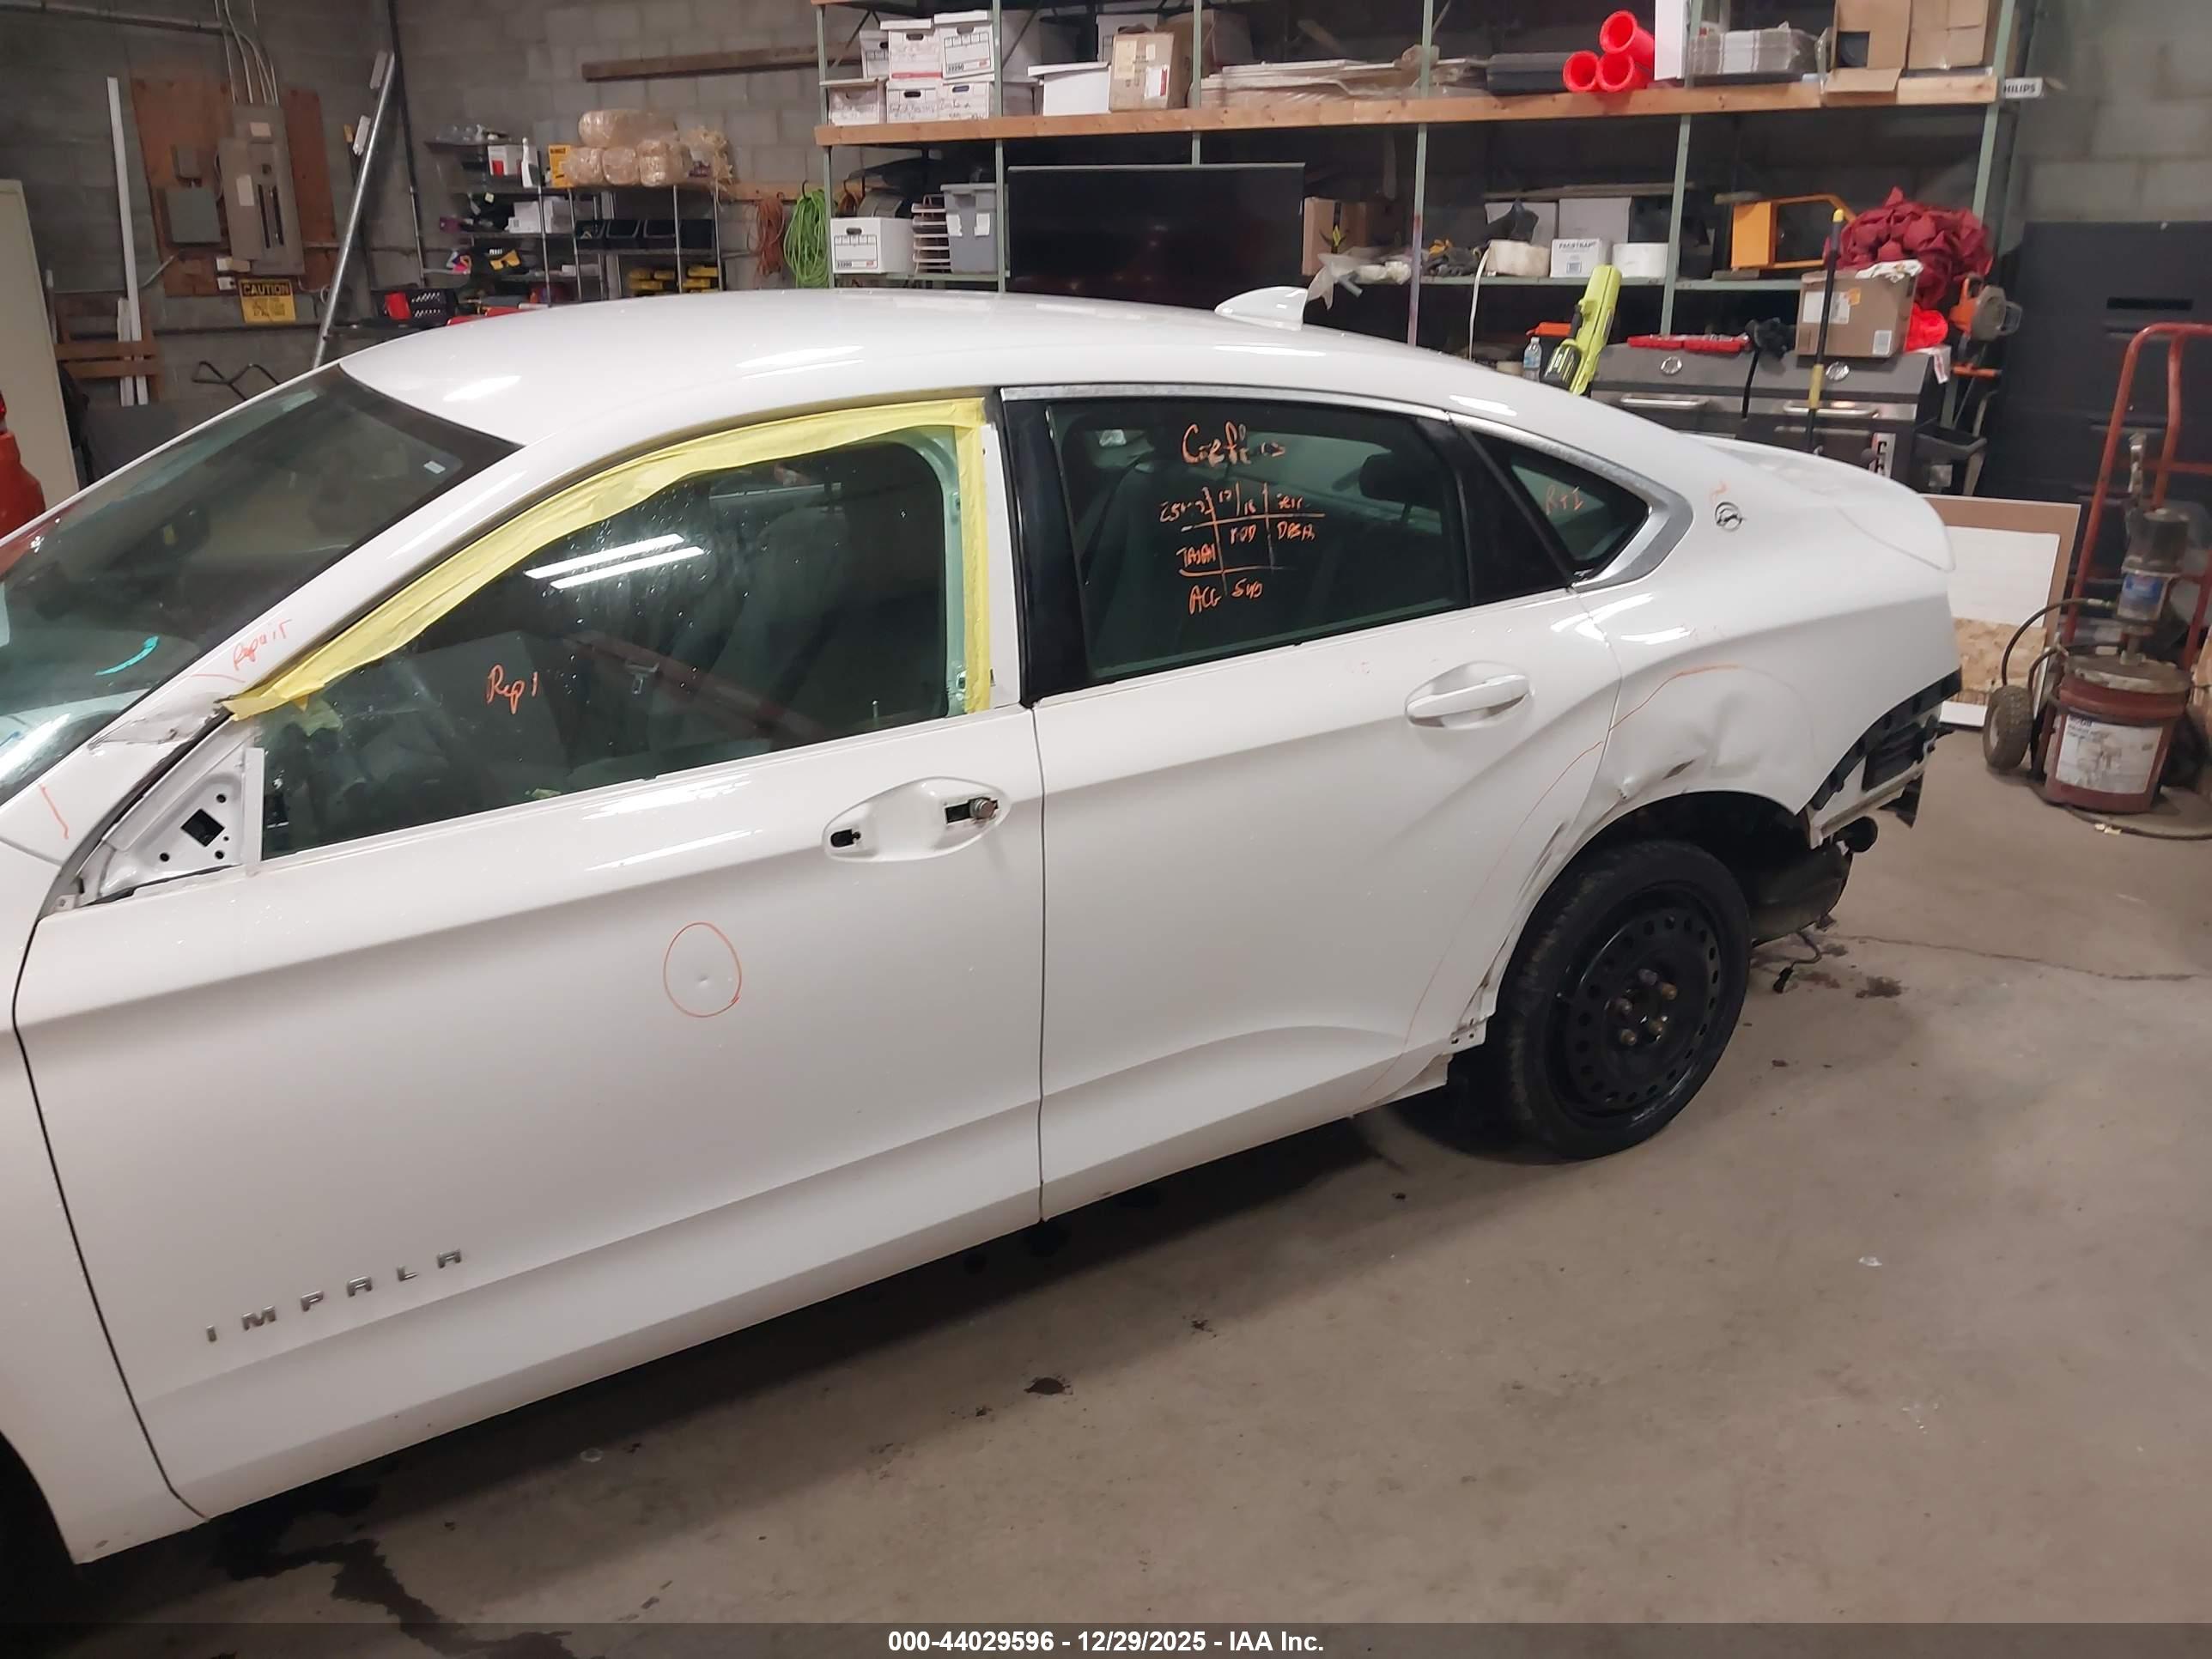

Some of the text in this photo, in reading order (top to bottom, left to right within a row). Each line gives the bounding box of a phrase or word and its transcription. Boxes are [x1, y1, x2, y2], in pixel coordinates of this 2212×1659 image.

[2003, 83, 2035, 94] HILIPS
[243, 284, 289, 296] CAUTION
[206, 1249, 462, 1342] IMPALA
